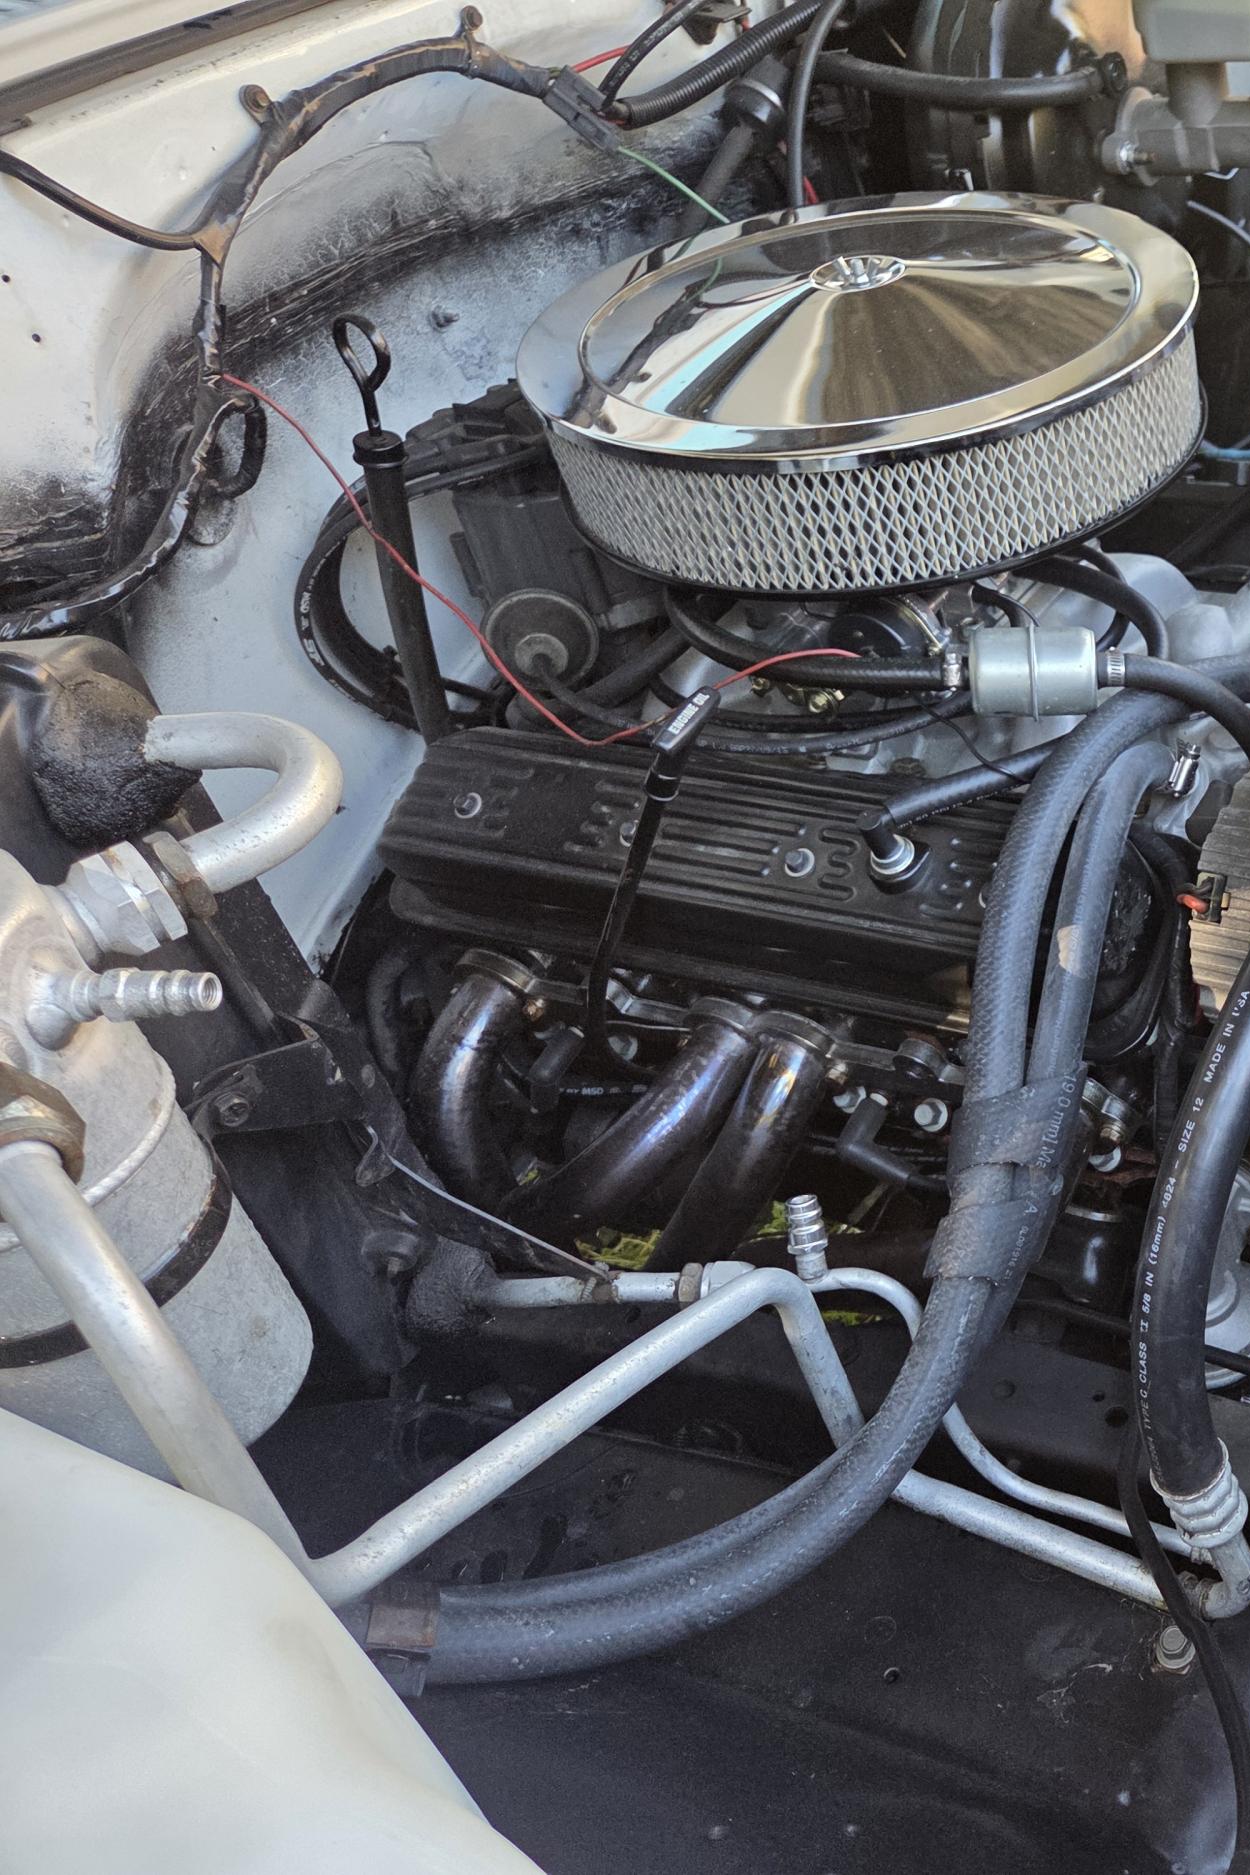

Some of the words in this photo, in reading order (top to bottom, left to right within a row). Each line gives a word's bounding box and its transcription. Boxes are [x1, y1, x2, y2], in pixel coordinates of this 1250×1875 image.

[667, 702, 700, 735] ENGINE
[692, 692, 710, 706] OIL
[1222, 1023, 1236, 1038] IN
[1203, 1042, 1227, 1083] MADE
[581, 1085, 604, 1096] MSD
[1192, 1096, 1204, 1113] 12
[1178, 1119, 1196, 1153] SIZE
[1147, 1216, 1166, 1265] (16mm)
[1144, 1271, 1154, 1287] IN
[1141, 1293, 1152, 1314] 5/8
[1138, 1341, 1148, 1384] CLASS
[1140, 1400, 1152, 1430] TYPE
